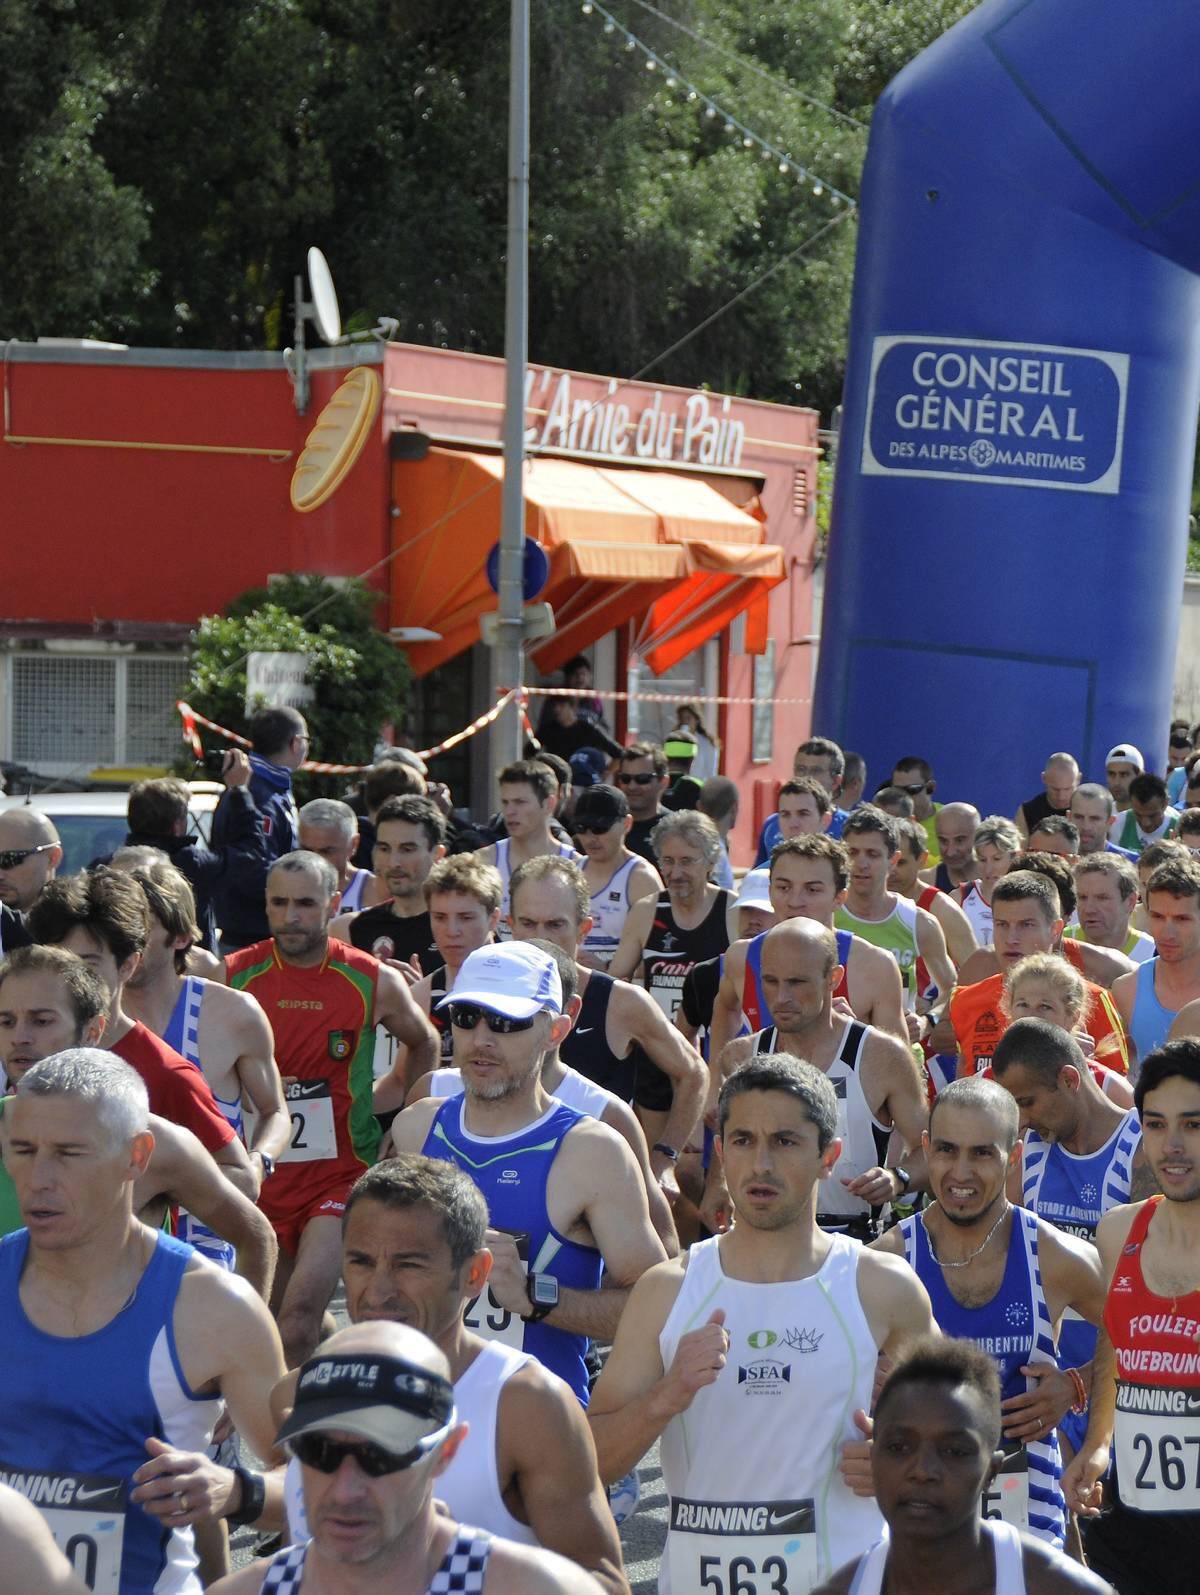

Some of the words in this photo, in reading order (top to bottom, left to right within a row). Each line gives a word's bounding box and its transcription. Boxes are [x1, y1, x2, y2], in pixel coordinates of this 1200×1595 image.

[912, 352, 1072, 397] CONSEIL
[637, 391, 677, 459] du
[683, 395, 744, 466] Pain
[895, 389, 1084, 441] GÉNÉRAL
[889, 442, 916, 456] DES
[919, 444, 967, 461] ALPES
[995, 450, 1086, 472] MARITIMES
[651, 961, 694, 976] Cari
[1038, 1201, 1064, 1216] STADE
[332, 1364, 379, 1380] STYLE
[748, 1366, 779, 1380] SFA
[1117, 1385, 1186, 1412] RUNNING
[676, 1503, 768, 1531] RUNNING
[700, 1555, 789, 1595] 563
